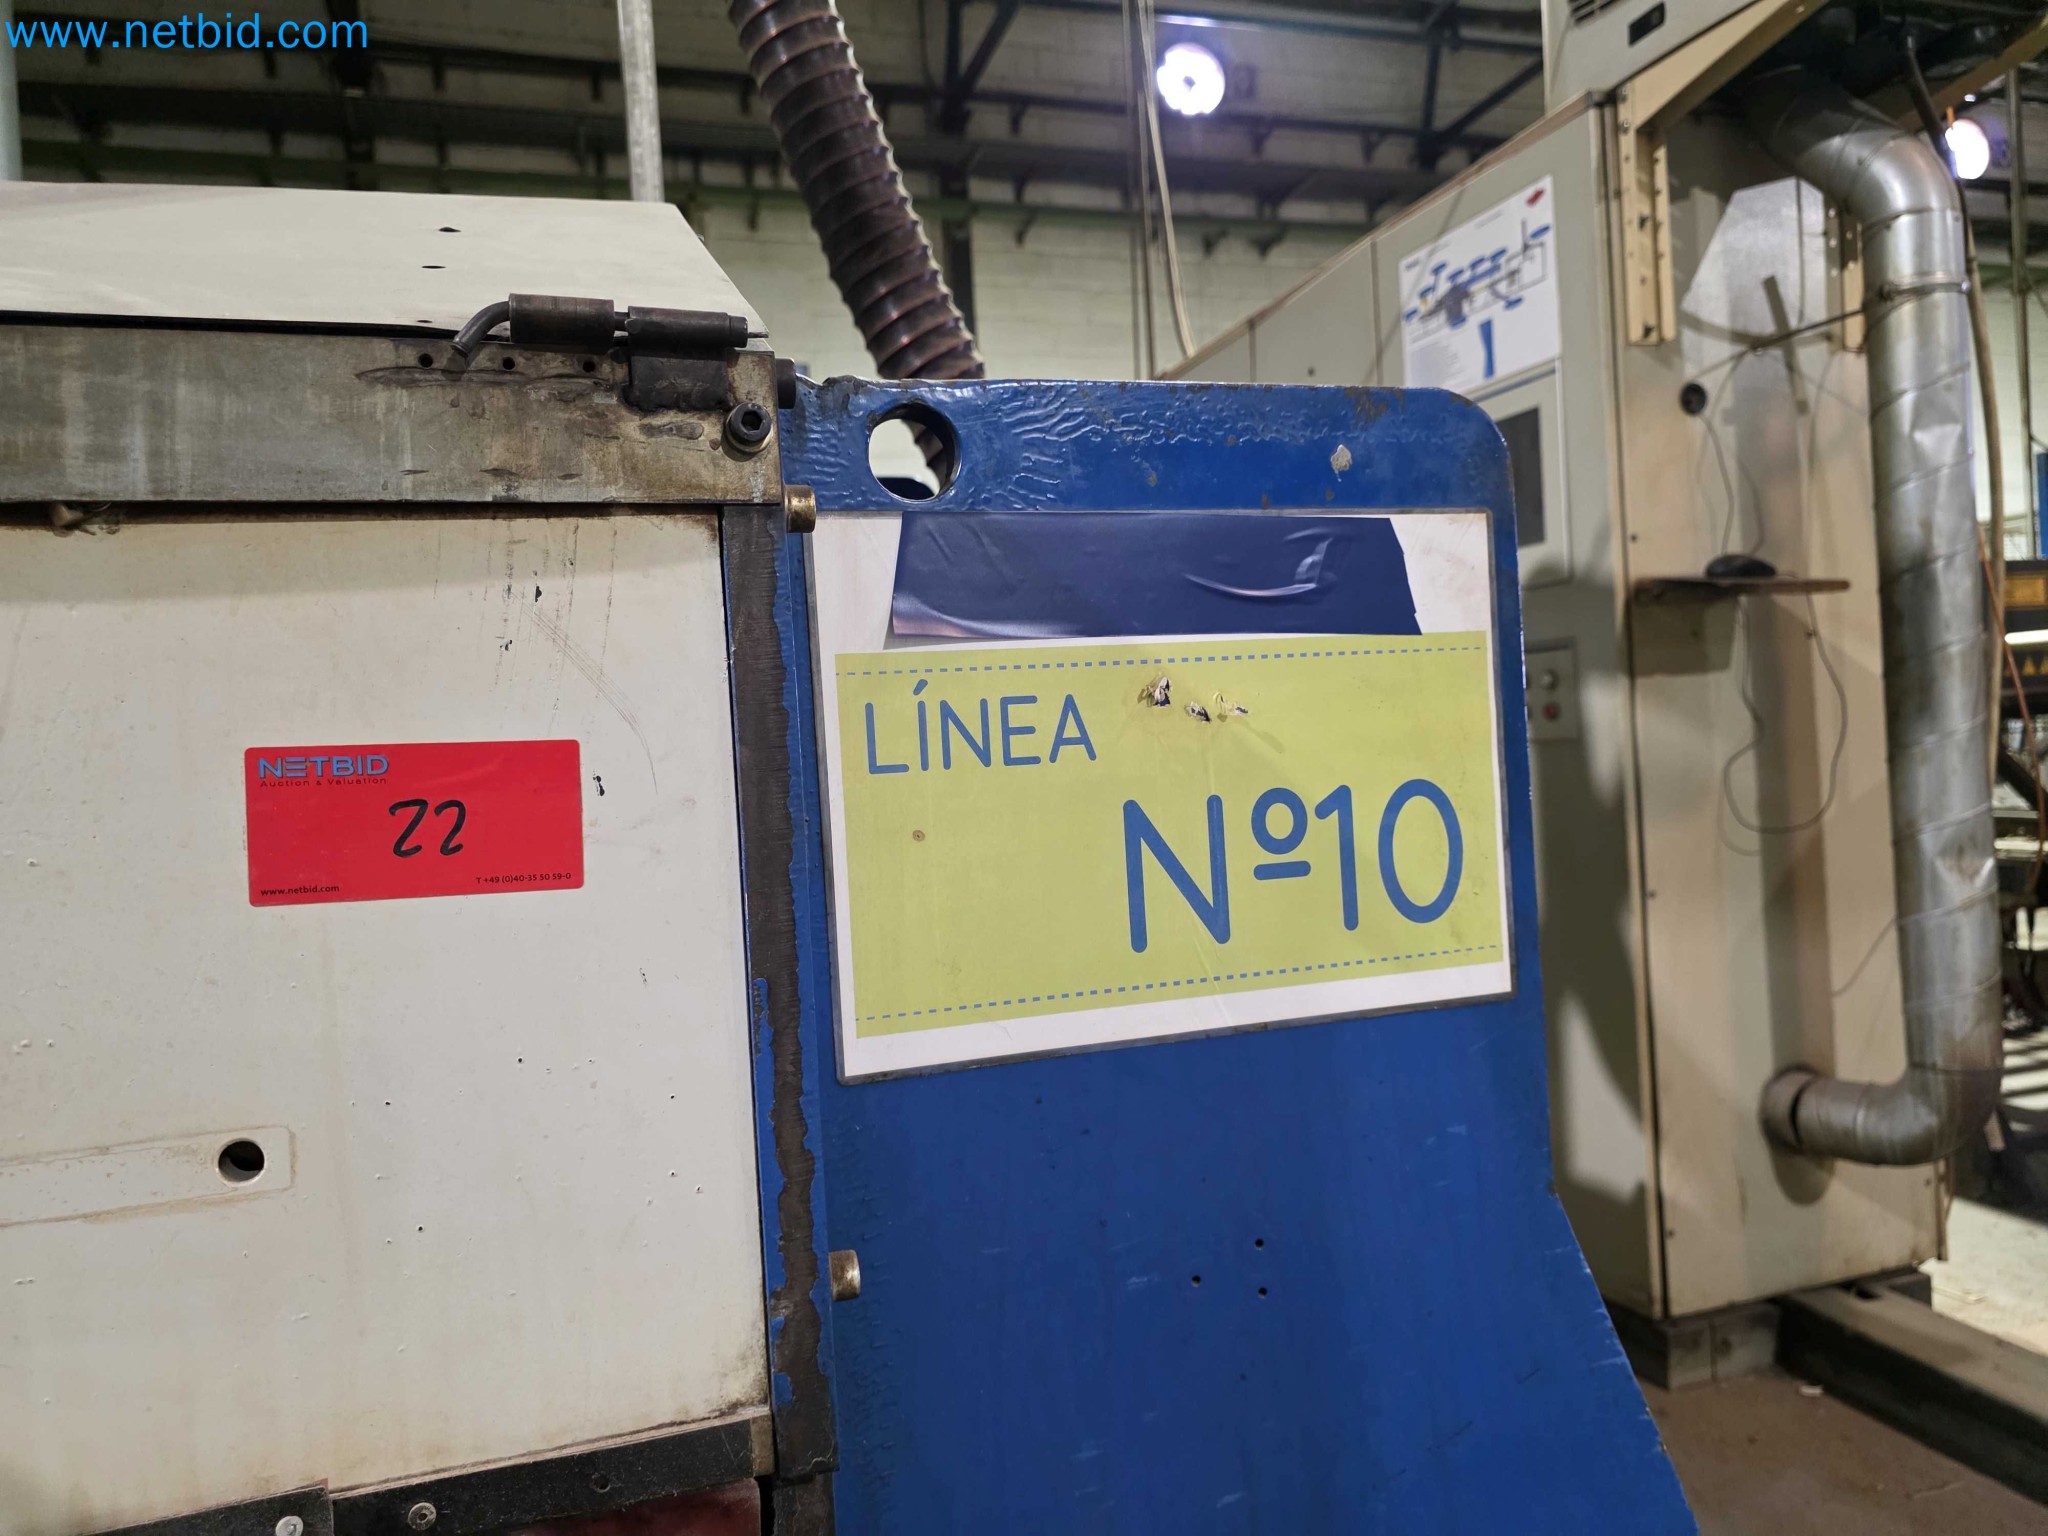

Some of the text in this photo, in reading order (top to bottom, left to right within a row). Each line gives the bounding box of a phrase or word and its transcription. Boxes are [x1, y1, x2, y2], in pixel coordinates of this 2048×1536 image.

[865, 679, 1097, 774] LÍNEA
[259, 755, 389, 779] NETBID
[260, 780, 310, 788] Auction
[327, 778, 387, 786] Valuation
[389, 798, 467, 858] 22
[1122, 778, 1463, 953] Nº10
[484, 876, 500, 884] +49
[501, 873, 538, 883] (0)40-35
[540, 873, 550, 881] 50
[552, 872, 572, 880] 59-0
[260, 885, 340, 896] www.netbid.com
